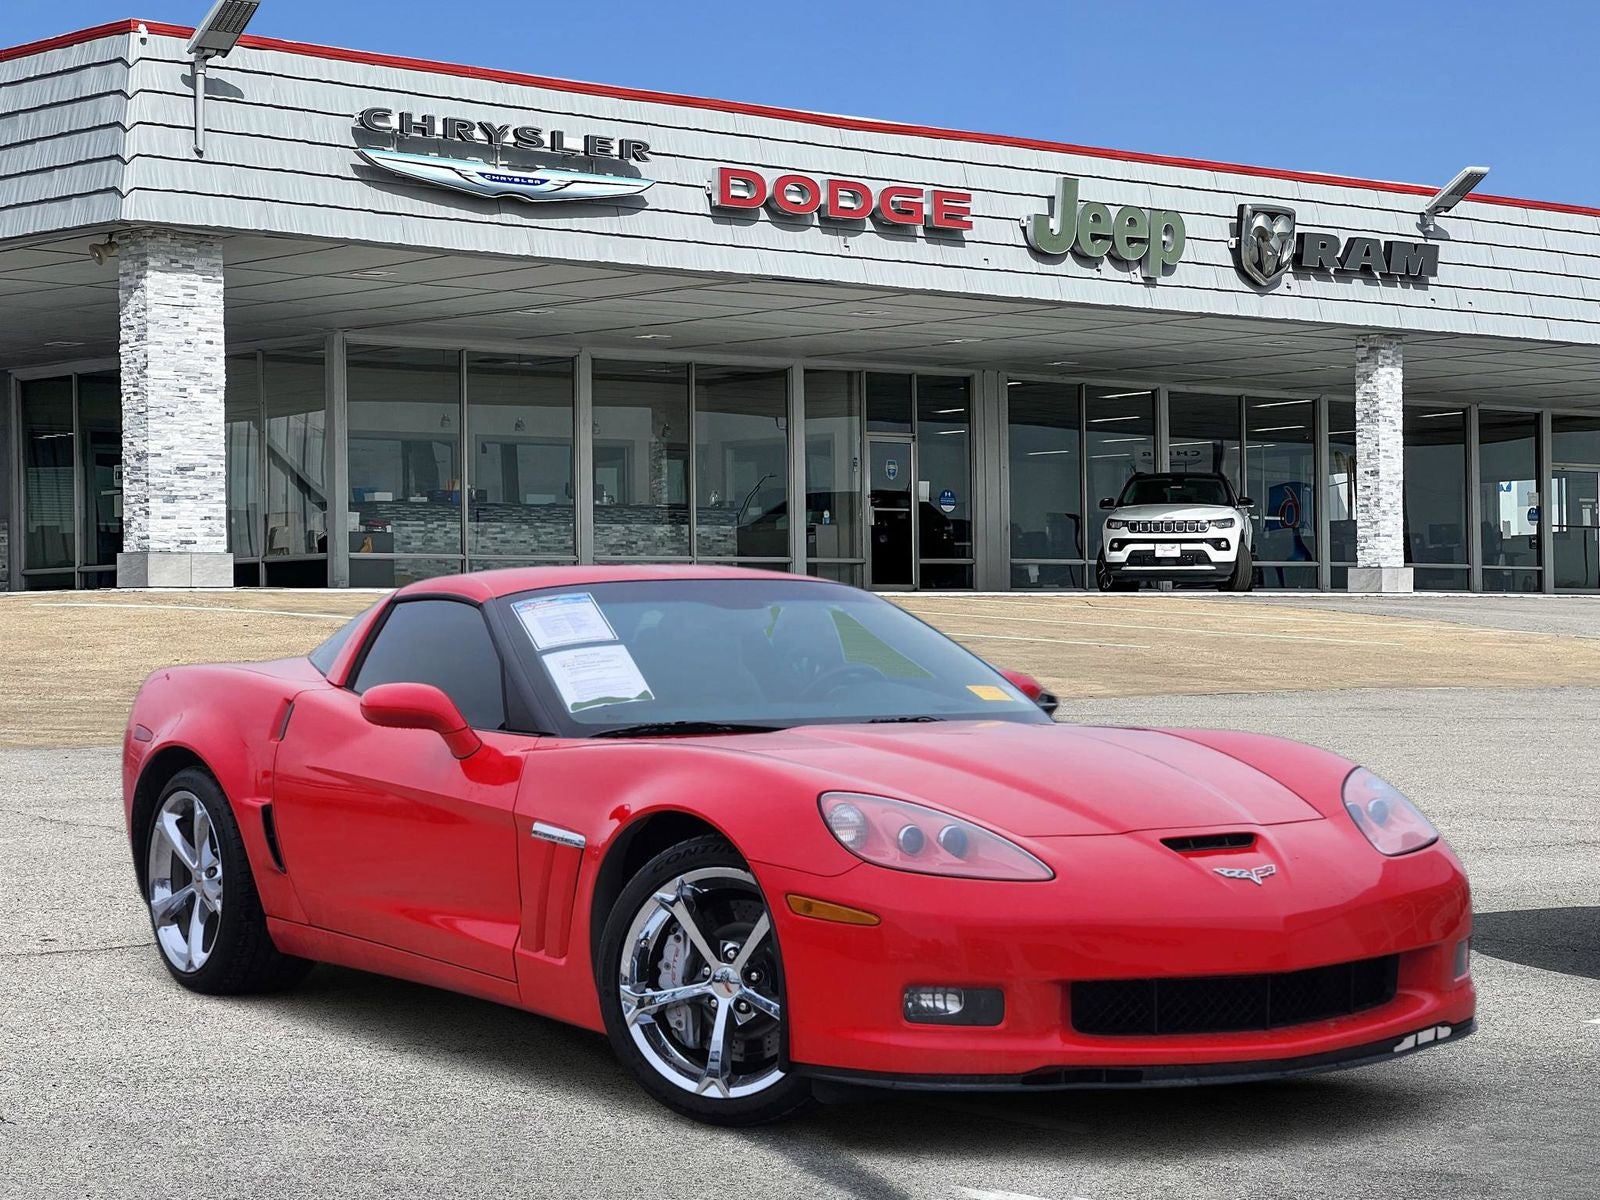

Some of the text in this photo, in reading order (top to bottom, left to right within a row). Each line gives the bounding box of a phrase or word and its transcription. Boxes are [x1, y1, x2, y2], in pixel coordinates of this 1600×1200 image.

[358, 107, 653, 162] CHRYSLER
[484, 174, 541, 185] CHRYSLER
[712, 166, 973, 230] DODGE
[1026, 176, 1186, 278] Jeep
[1297, 232, 1440, 278] RAM
